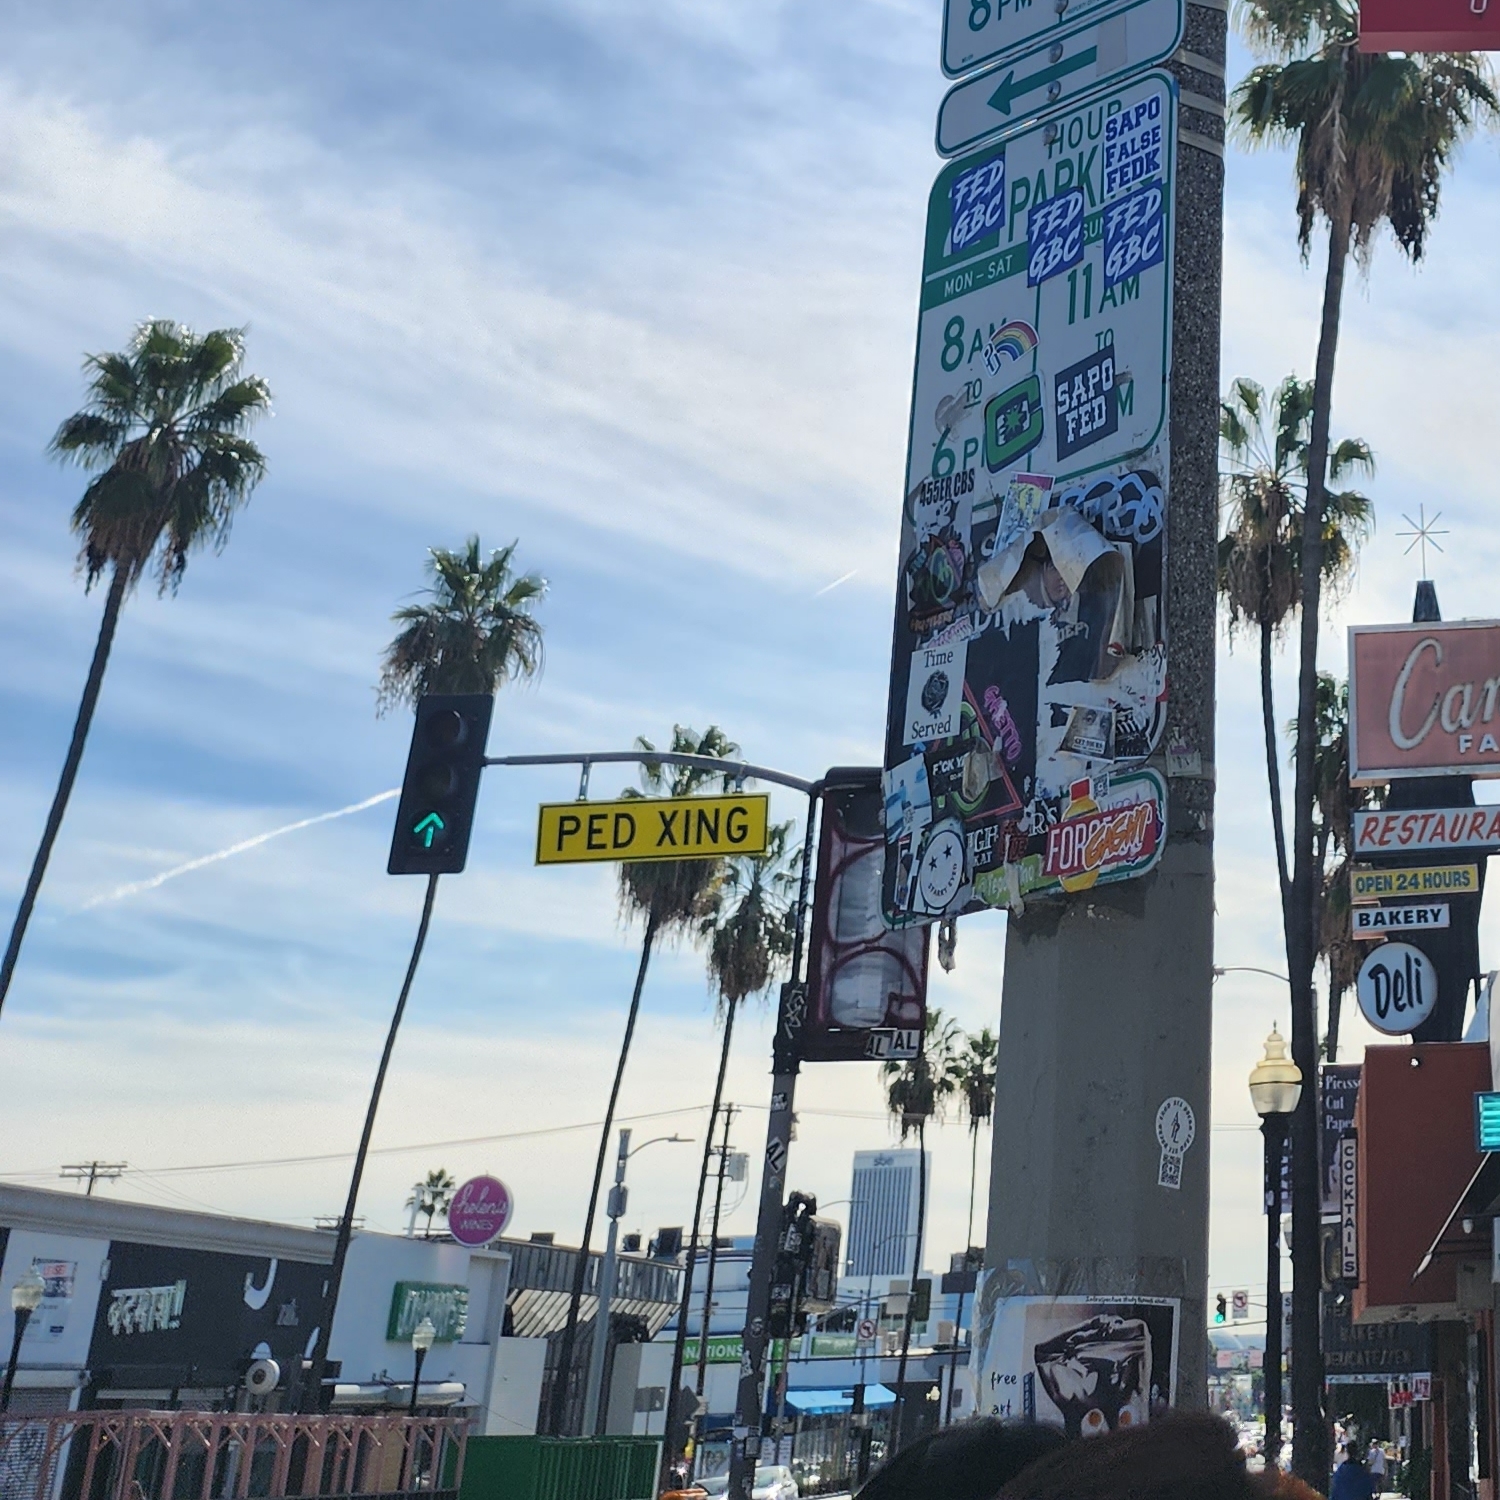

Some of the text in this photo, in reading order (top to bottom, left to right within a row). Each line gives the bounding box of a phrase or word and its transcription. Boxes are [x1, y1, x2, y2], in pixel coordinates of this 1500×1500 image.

[1105, 95, 1161, 143] SAPO
[1105, 124, 1161, 169] FALSE
[954, 159, 1004, 213] FED
[1106, 146, 1161, 195] FEDK
[1030, 190, 1084, 246] FED
[1106, 187, 1162, 243] FED
[963, 378, 982, 403] TO
[1057, 357, 1114, 416] SAPO
[1065, 394, 1107, 443] FED
[924, 649, 953, 668] Time
[911, 714, 952, 739] Served
[556, 806, 750, 851] PED XING
[1355, 869, 1471, 893] OPEN 24 HOURS
[1358, 908, 1442, 927] BAKERY
[1368, 952, 1423, 1020] Deli
[1325, 1095, 1344, 1110] Cut
[1343, 1146, 1356, 1273] COCKTAILS
[991, 1371, 1018, 1391] free
[992, 1398, 1011, 1418] art
